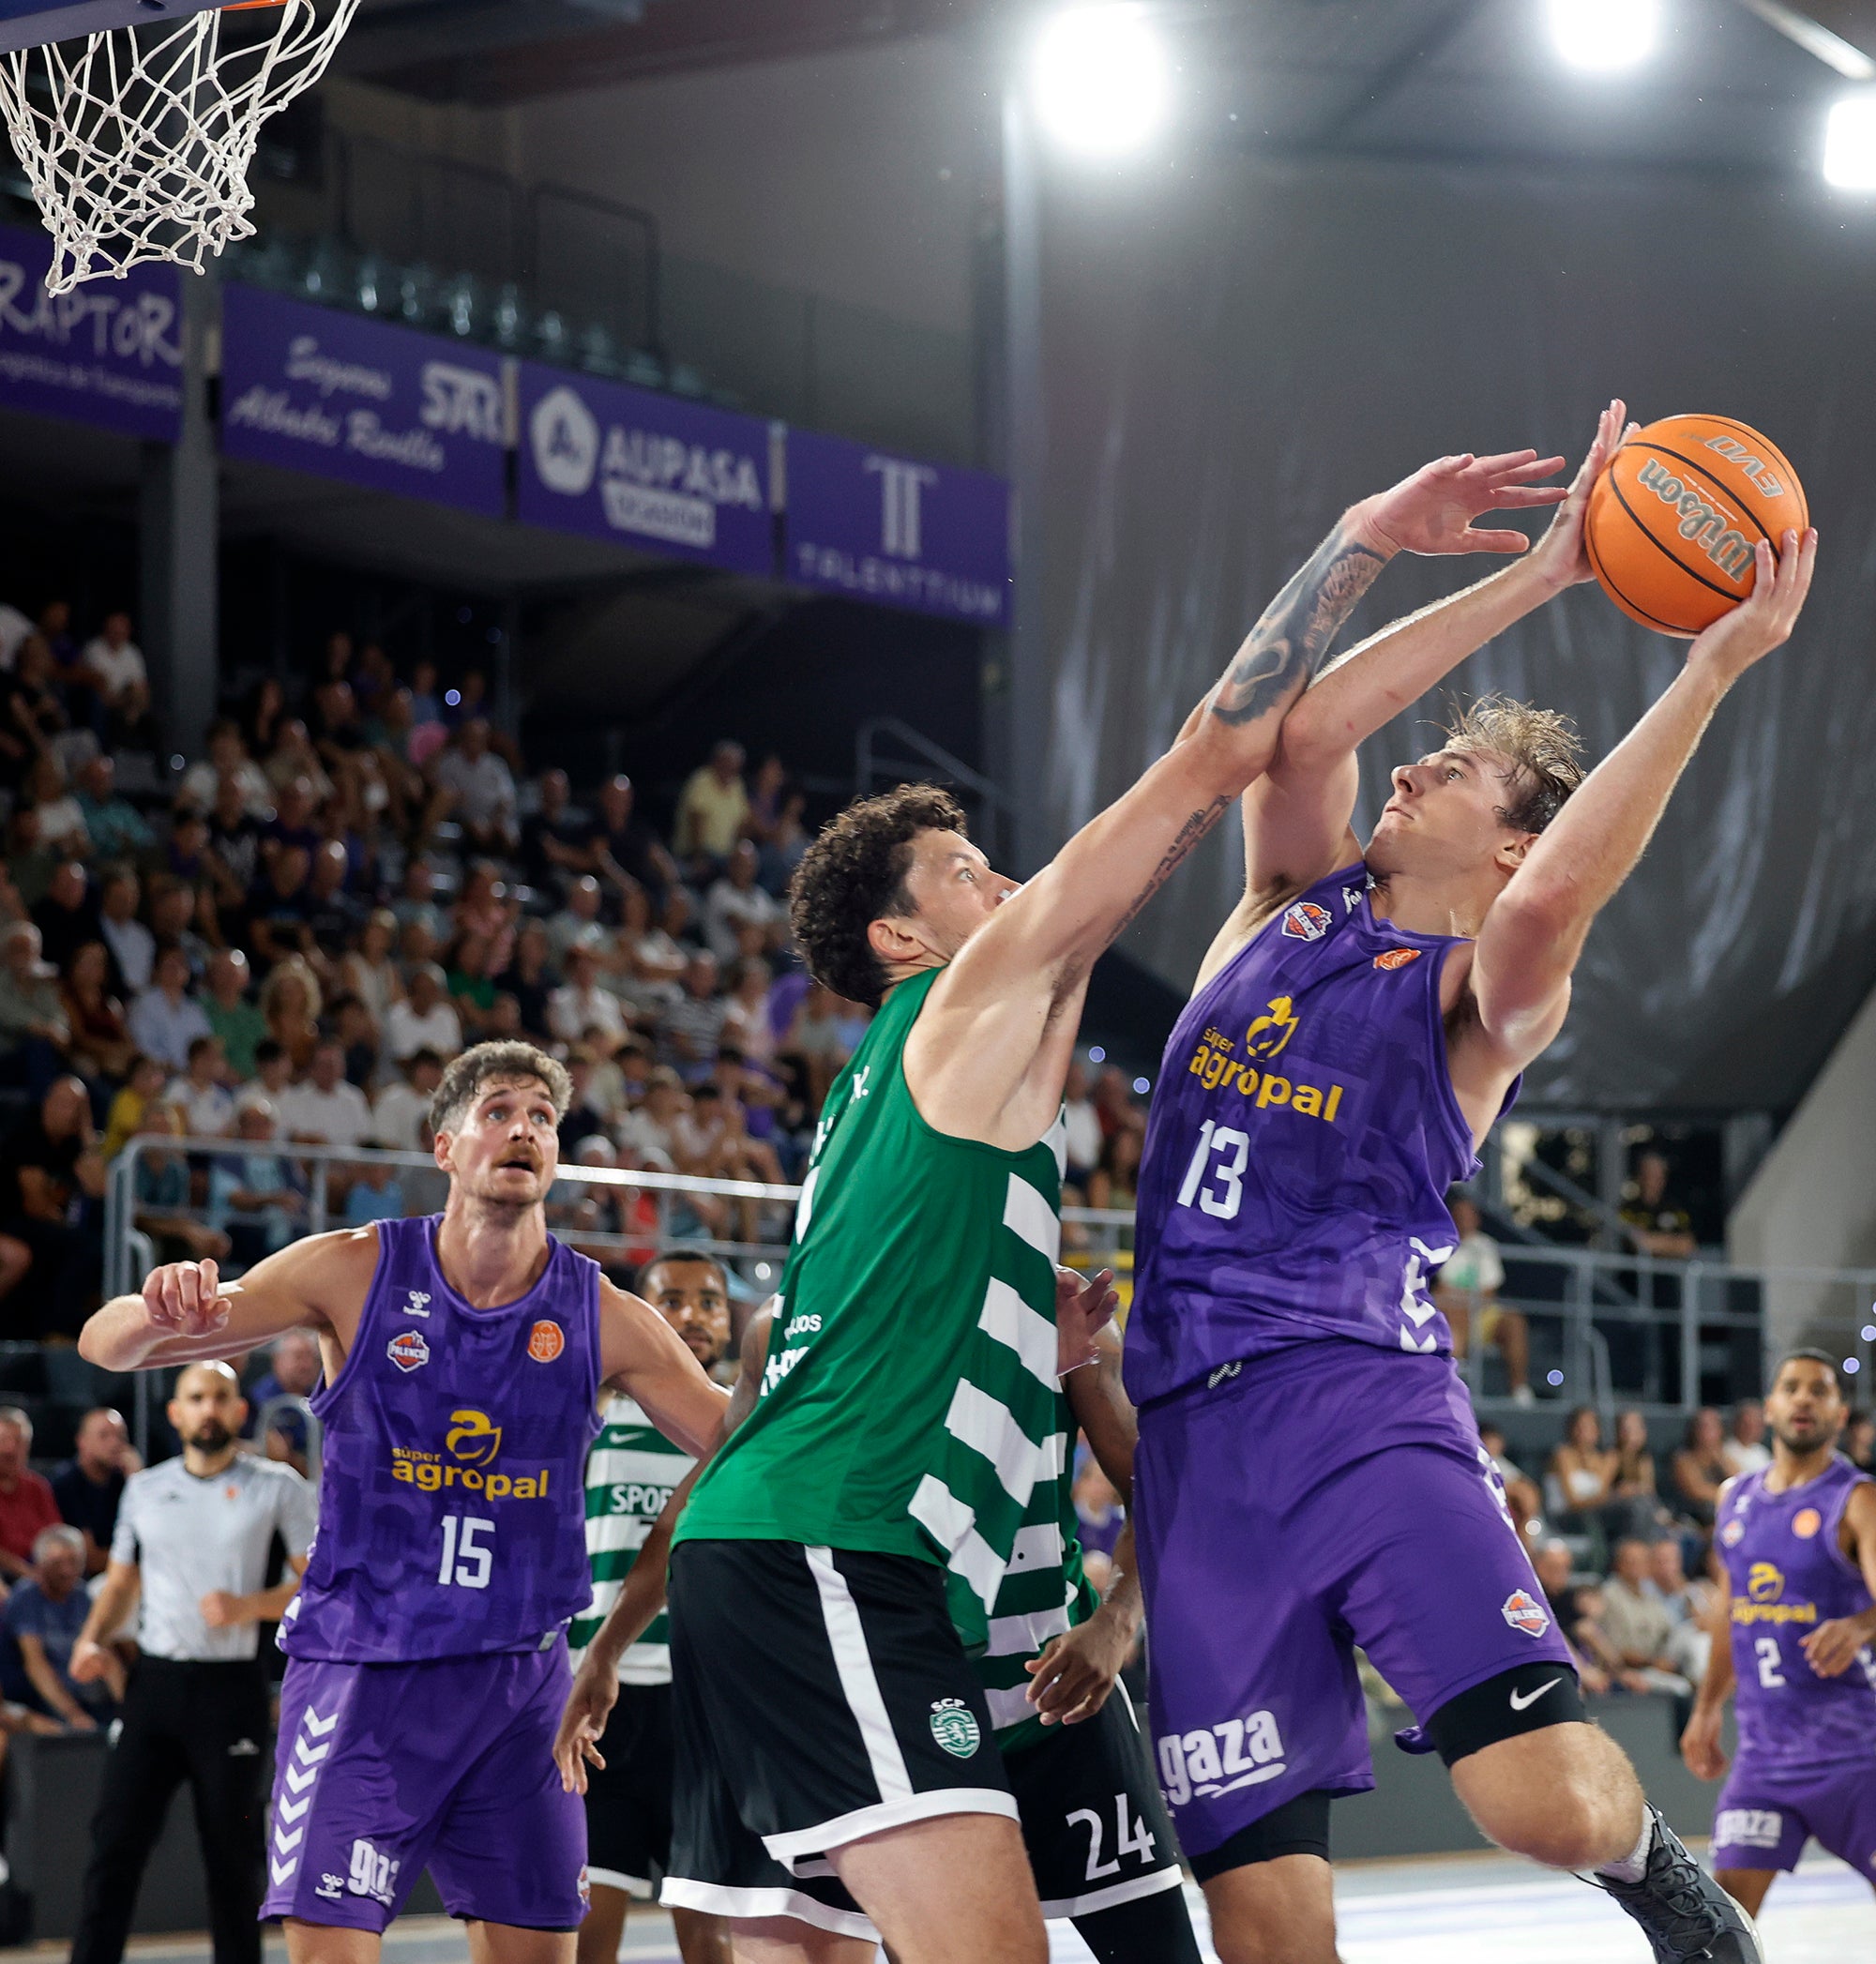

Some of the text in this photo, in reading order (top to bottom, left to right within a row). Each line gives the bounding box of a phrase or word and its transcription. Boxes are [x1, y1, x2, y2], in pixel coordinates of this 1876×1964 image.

[602, 424, 763, 512] AUPASA
[1636, 457, 1757, 583] Wilson
[1188, 1045, 1344, 1123] agropal
[1176, 1119, 1250, 1219] 13
[391, 1459, 550, 1502] agropal
[438, 1515, 496, 1590] 15
[1754, 1637, 1787, 1689] 2
[930, 1698, 966, 1713] SCP
[1157, 1710, 1286, 1806] gaza
[1066, 1792, 1157, 1881] 24
